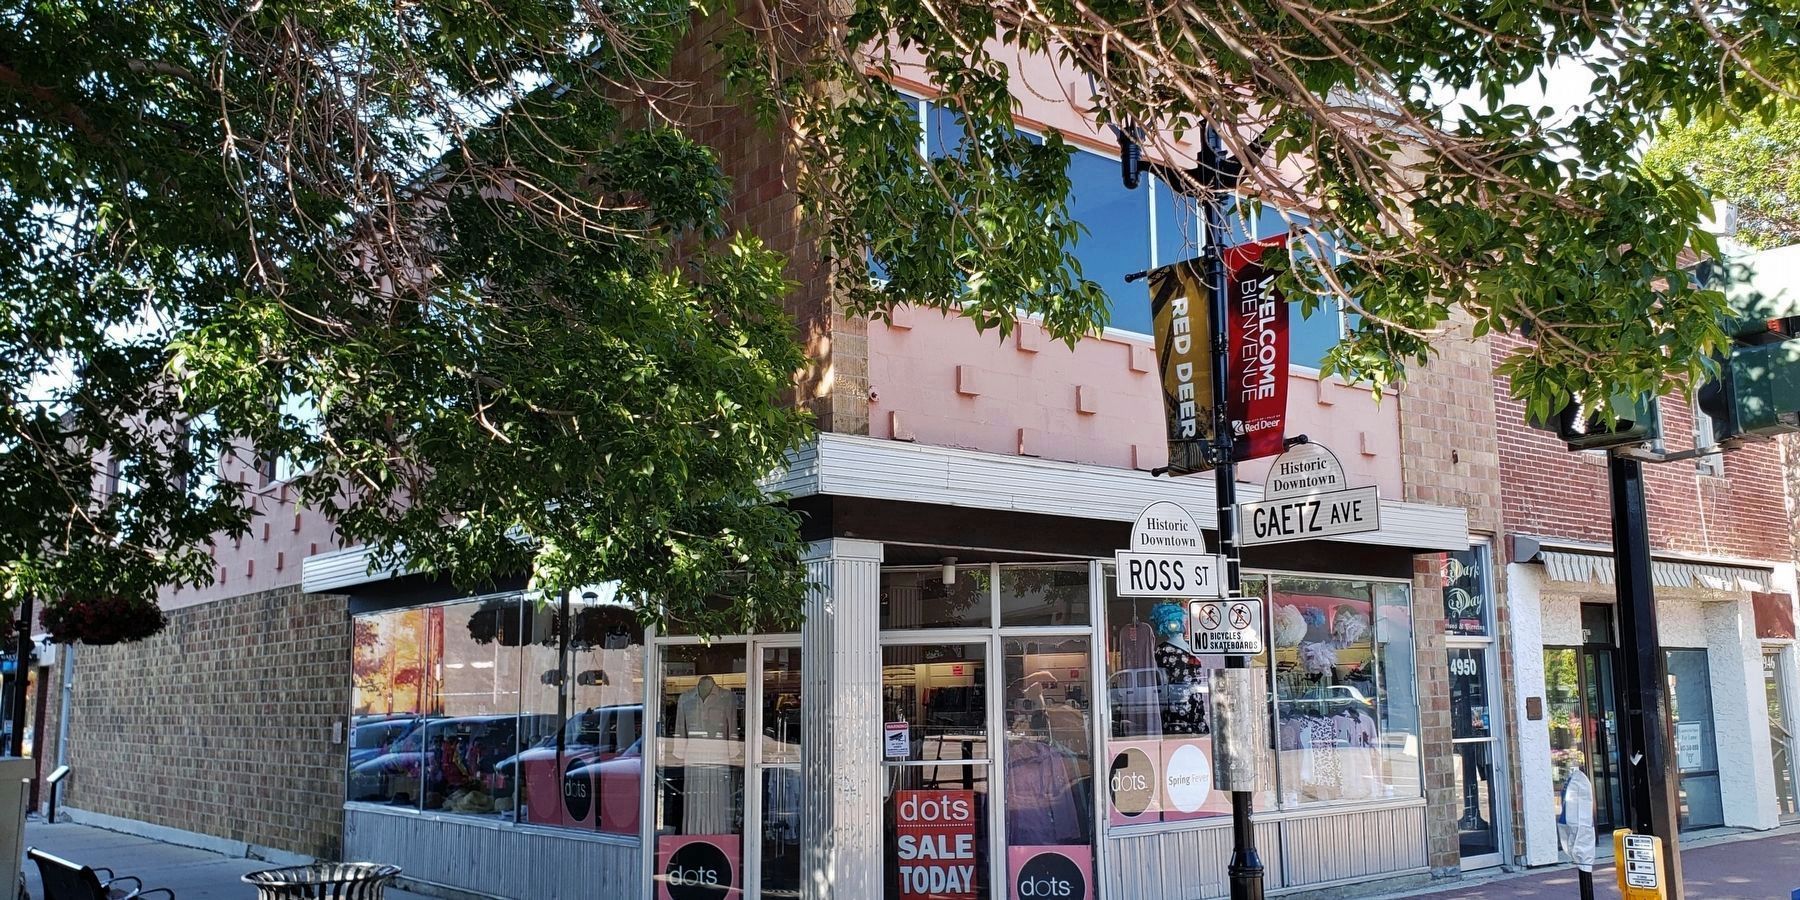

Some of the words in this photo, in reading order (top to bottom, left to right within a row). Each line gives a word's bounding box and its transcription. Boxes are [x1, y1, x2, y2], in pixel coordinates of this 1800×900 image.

[1171, 297, 1191, 355] RED
[1241, 278, 1258, 403] BIENVENUE
[1258, 274, 1277, 400] WELCOME
[1176, 362, 1196, 439] DEER
[1244, 421, 1260, 433] Red
[1260, 419, 1281, 430] Deer
[1279, 457, 1327, 476] Historic
[1273, 474, 1336, 492] Downtown
[1147, 517, 1189, 532] Historic
[1253, 501, 1322, 539] GAETZ
[1330, 500, 1363, 525] AVE
[1140, 532, 1196, 548] Downtown
[1130, 559, 1185, 591] ROSS
[1194, 566, 1209, 586] ST
[1448, 587, 1484, 618] Day
[1194, 632, 1208, 650] NO
[1210, 632, 1242, 641] BICYCLES
[1210, 641, 1258, 650] SKATEBOARDS
[1450, 658, 1477, 676] 4950
[564, 778, 586, 798] dots
[1111, 771, 1146, 792] dots
[1168, 775, 1190, 787] Spring
[1191, 773, 1209, 783] Fever
[900, 794, 969, 821] dots
[898, 833, 974, 860] SALE
[668, 864, 718, 886] dots
[899, 864, 975, 895] TODAY
[1020, 874, 1072, 898] dots
